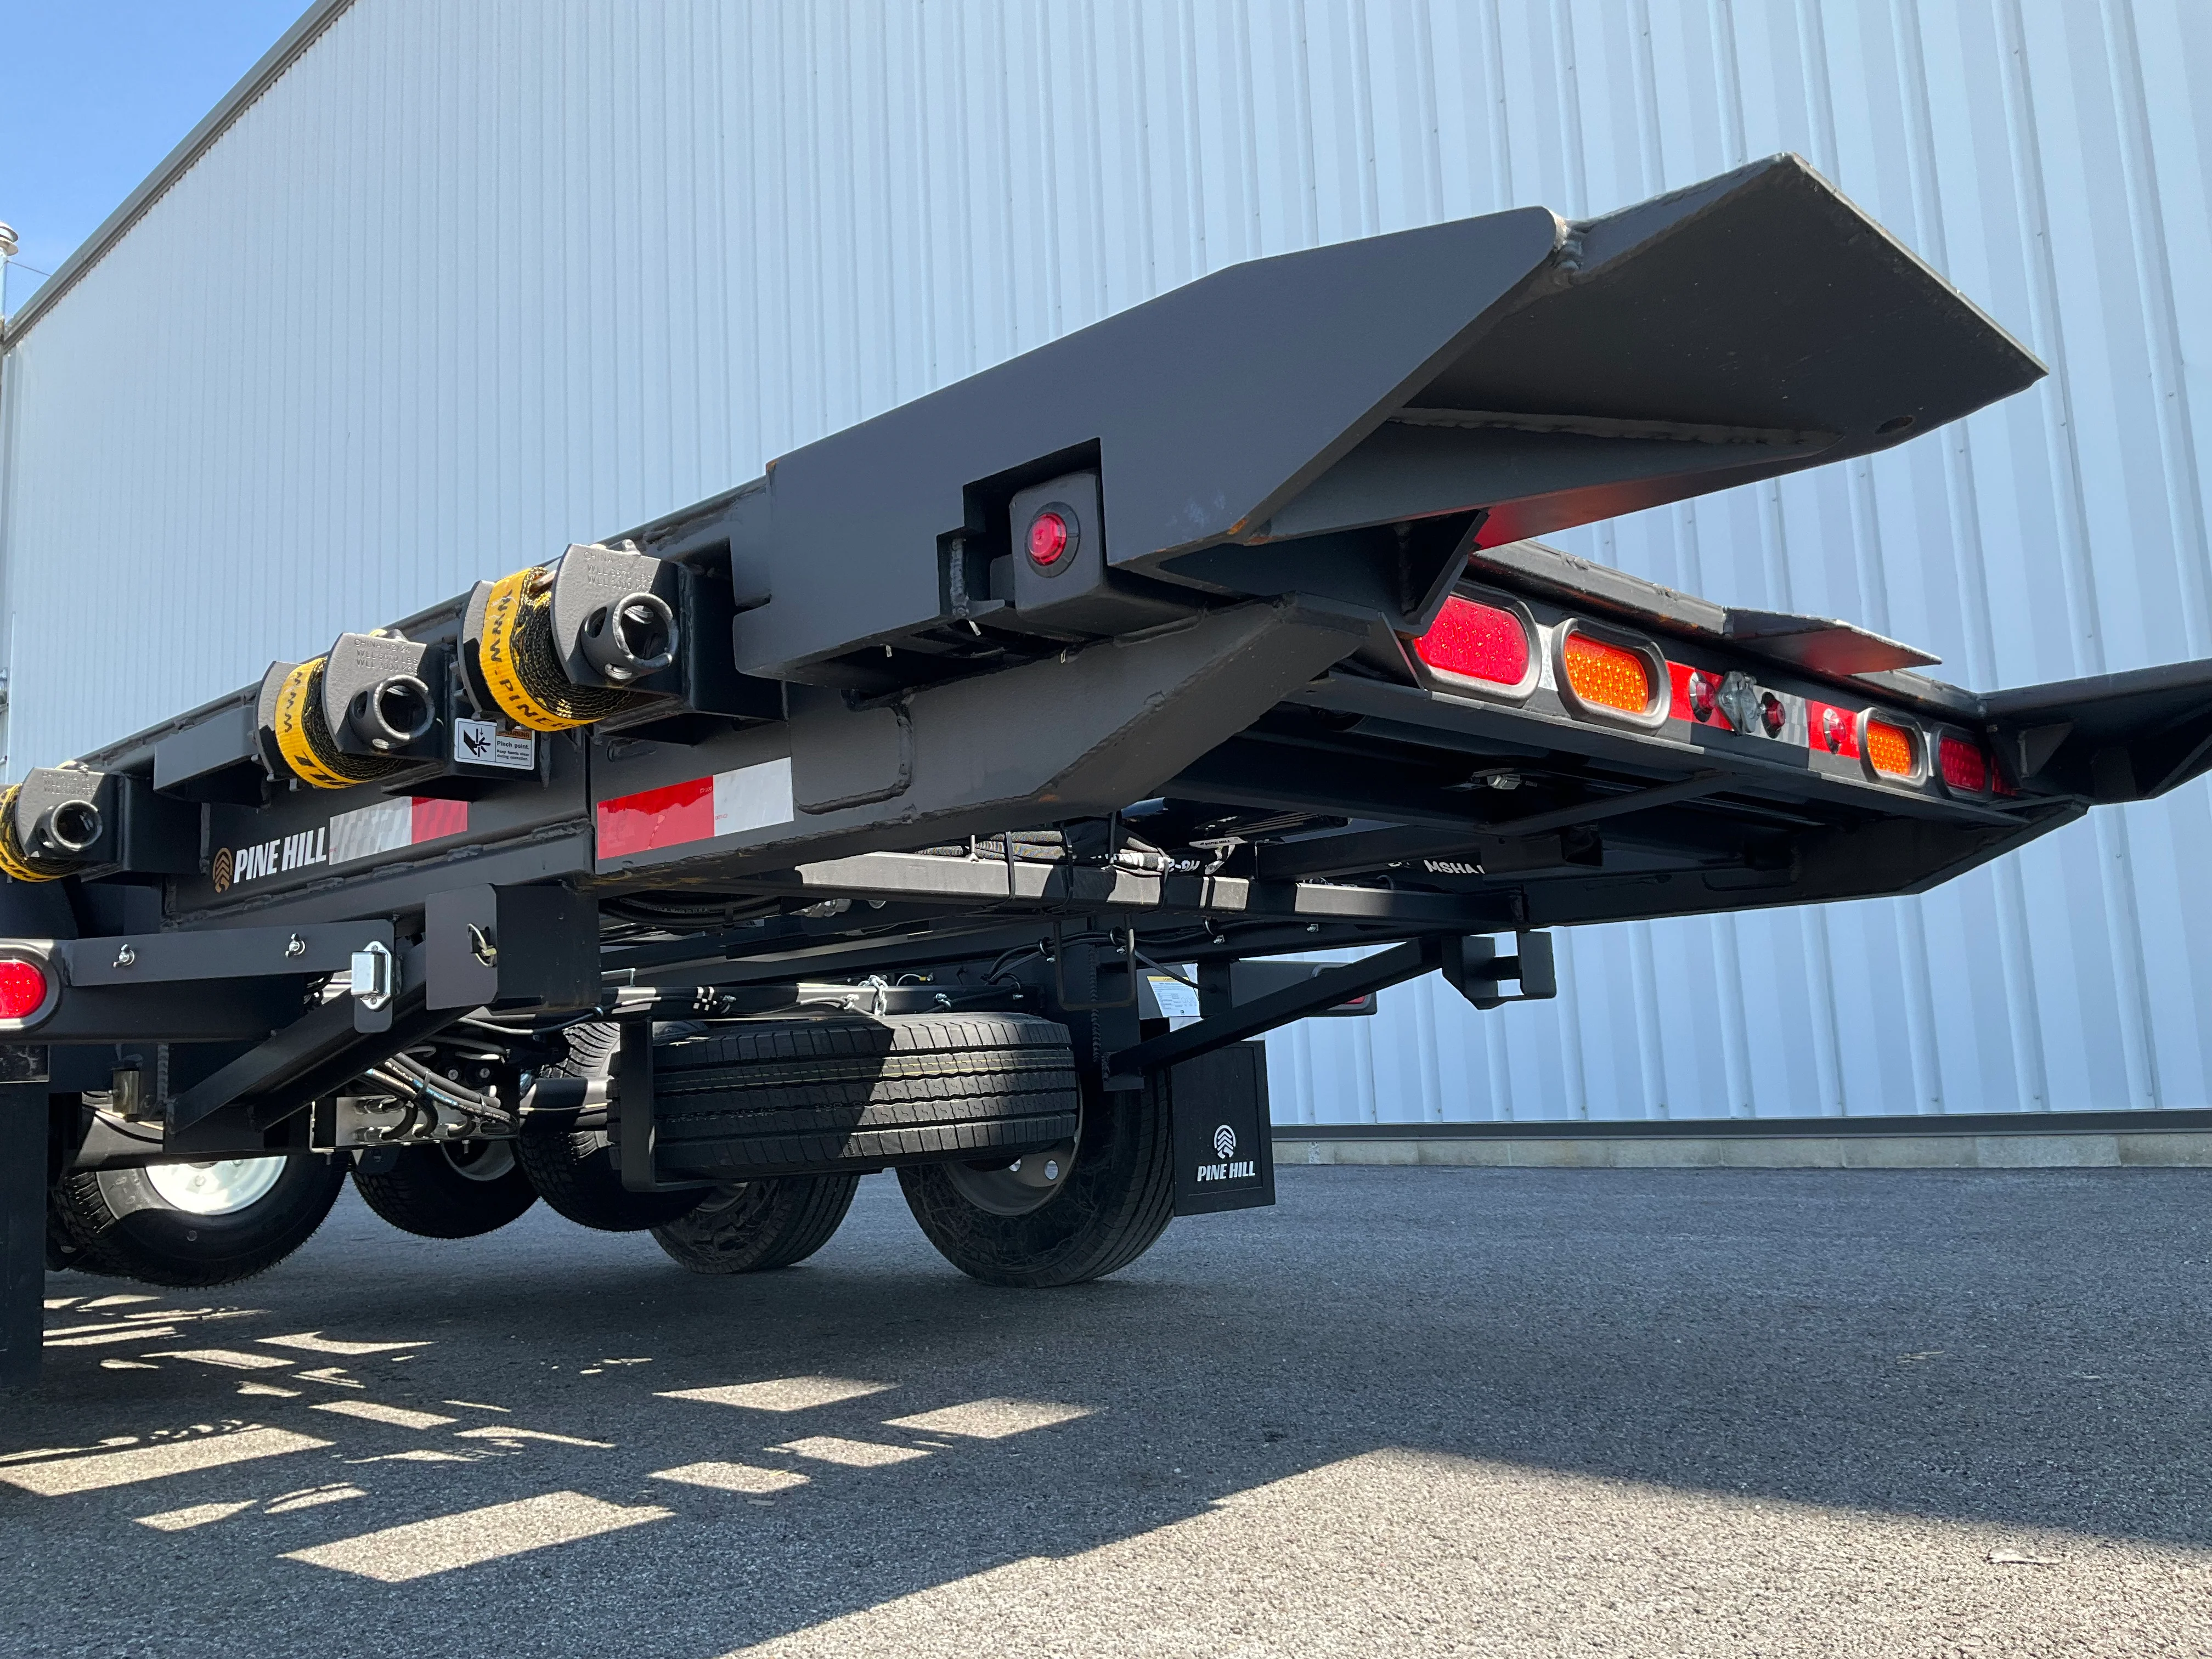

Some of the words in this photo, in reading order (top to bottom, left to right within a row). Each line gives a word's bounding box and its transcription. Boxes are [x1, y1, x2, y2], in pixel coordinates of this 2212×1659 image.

[584, 551, 613, 563] CHINA
[587, 563, 608, 576] WLL
[587, 575, 609, 587] WLL
[354, 638, 382, 648] CHINA
[357, 649, 376, 659] WLL
[378, 652, 399, 663] 6670
[402, 656, 418, 665] LBS
[357, 658, 376, 669] WLL
[379, 662, 399, 672] 3000
[233, 838, 281, 884] PINE
[281, 826, 328, 872] HILL
[1424, 860, 1480, 874] MSHA
[1197, 1163, 1228, 1182] PINE
[1228, 1160, 1256, 1178] HILL
